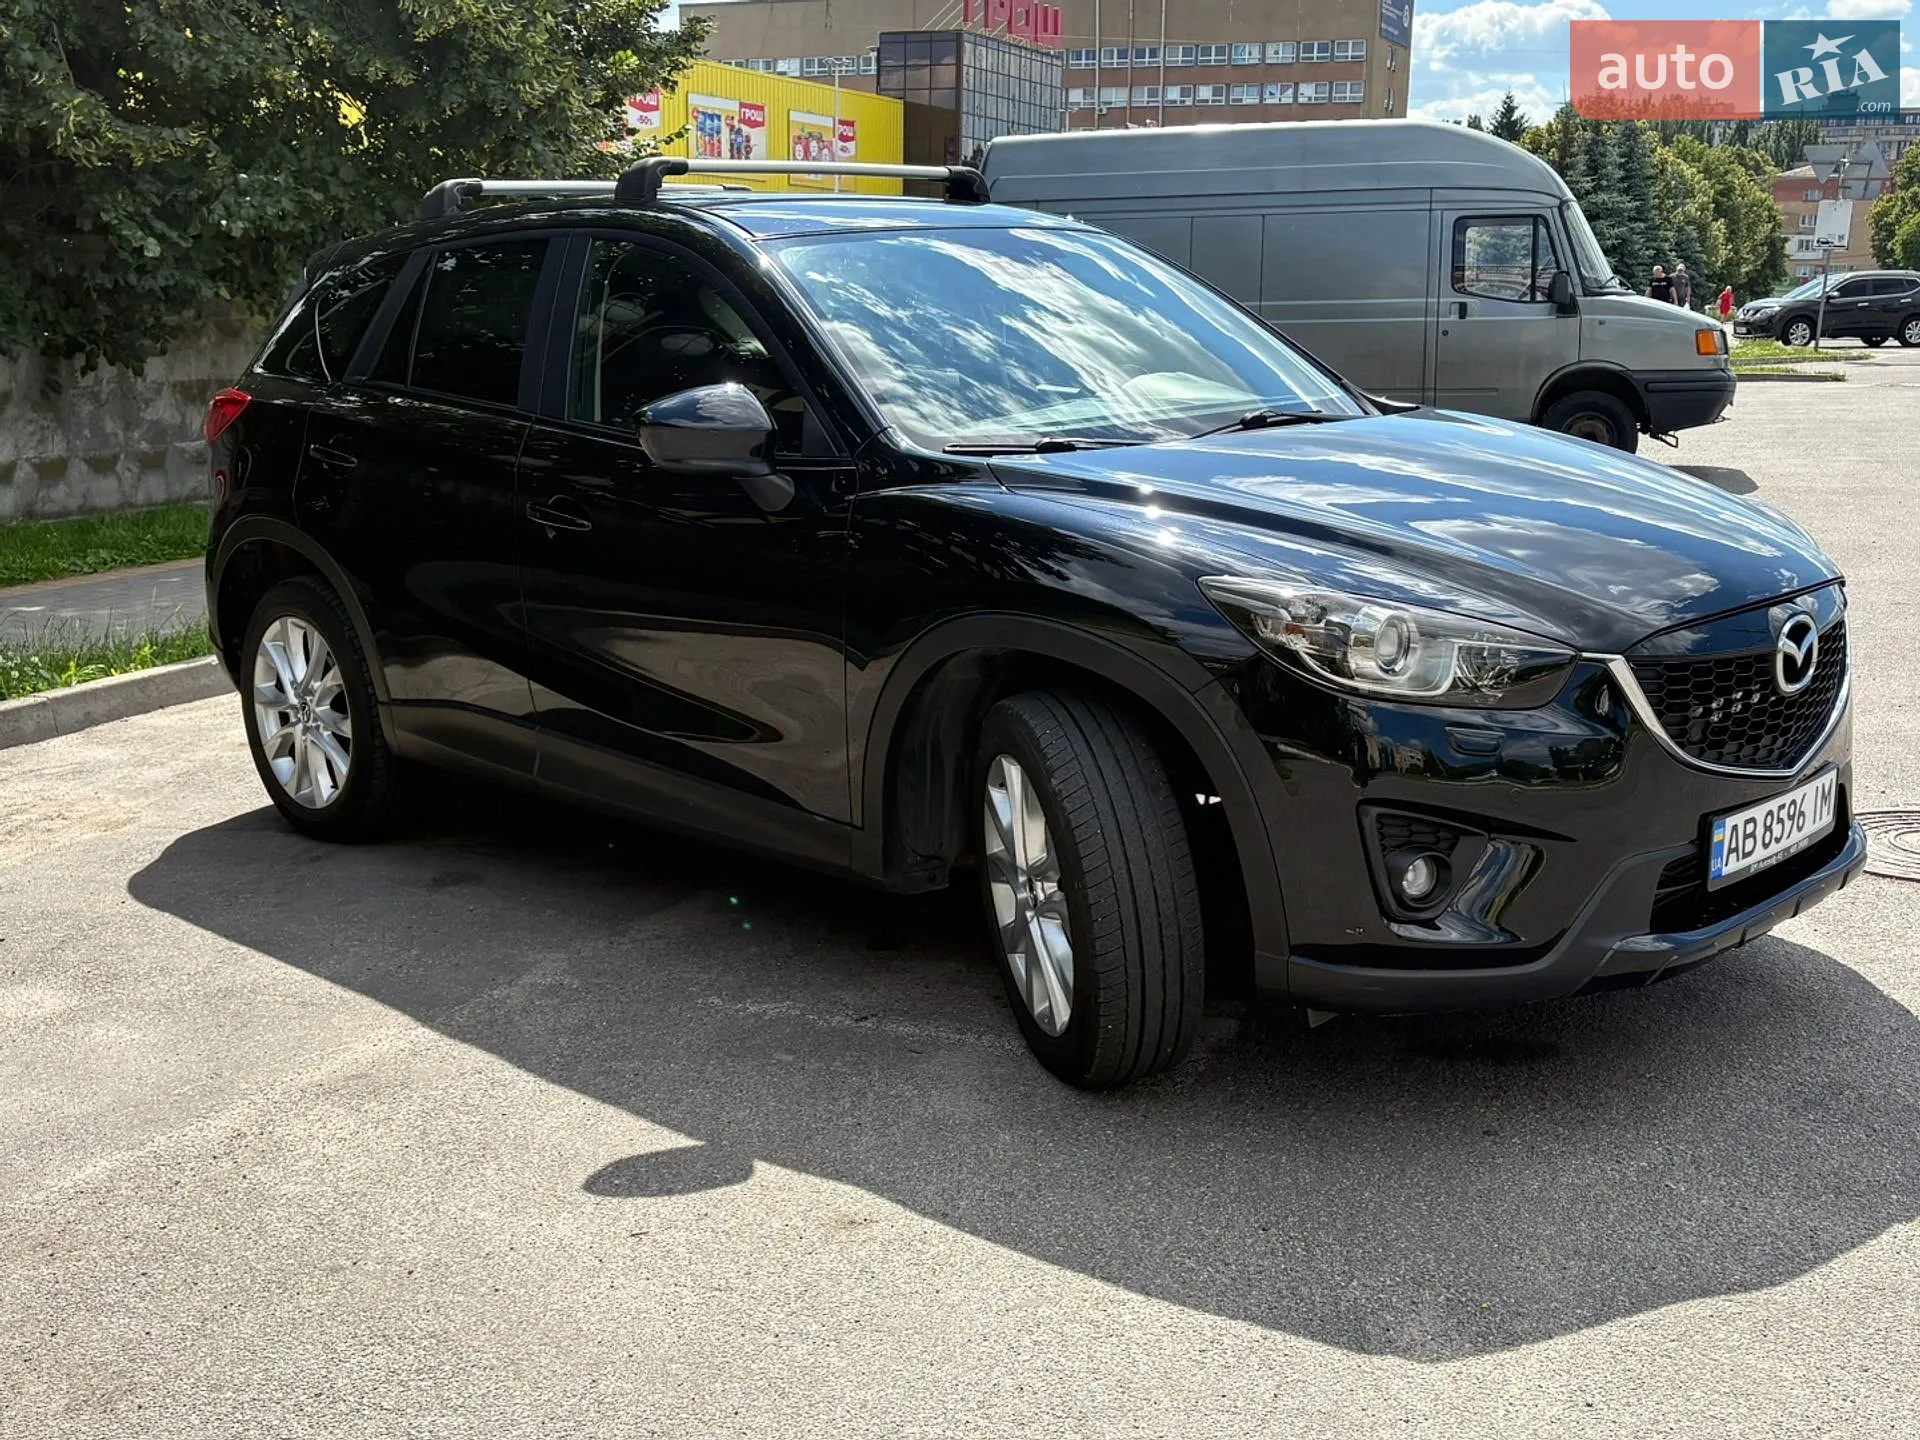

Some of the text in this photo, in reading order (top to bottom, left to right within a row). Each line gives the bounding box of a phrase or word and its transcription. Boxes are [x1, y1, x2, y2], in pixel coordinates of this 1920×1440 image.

[740, 107, 764, 122] ГРОШ
[1724, 816, 1757, 867] AB
[1762, 792, 1807, 850] 8596
[1812, 778, 1833, 825] IM
[1711, 857, 1724, 872] UA
